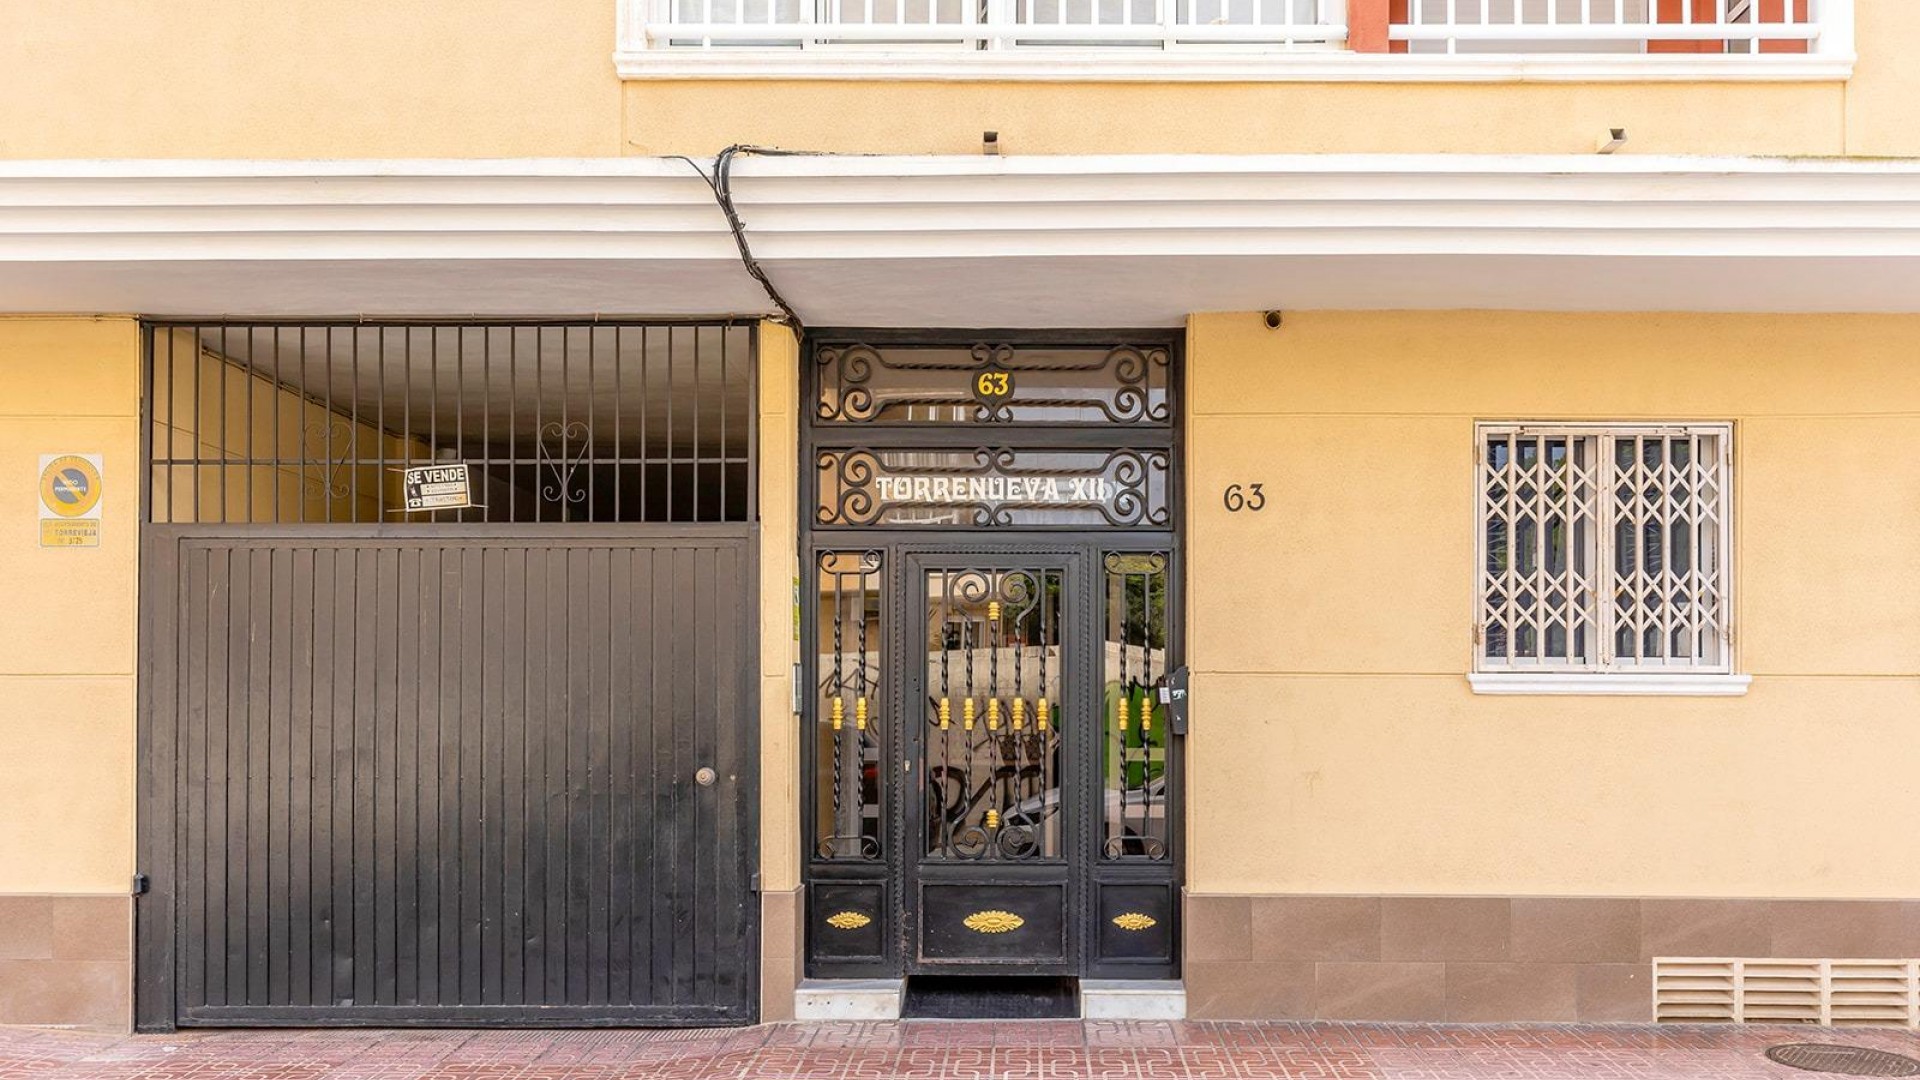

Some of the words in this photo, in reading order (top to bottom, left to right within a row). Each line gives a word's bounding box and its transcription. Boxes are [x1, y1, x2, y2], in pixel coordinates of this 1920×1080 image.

[978, 372, 1009, 395] 63
[407, 471, 422, 485] SE
[424, 468, 465, 483] VENDE
[876, 477, 1060, 502] TORRENUEVA
[1223, 483, 1265, 512] 63
